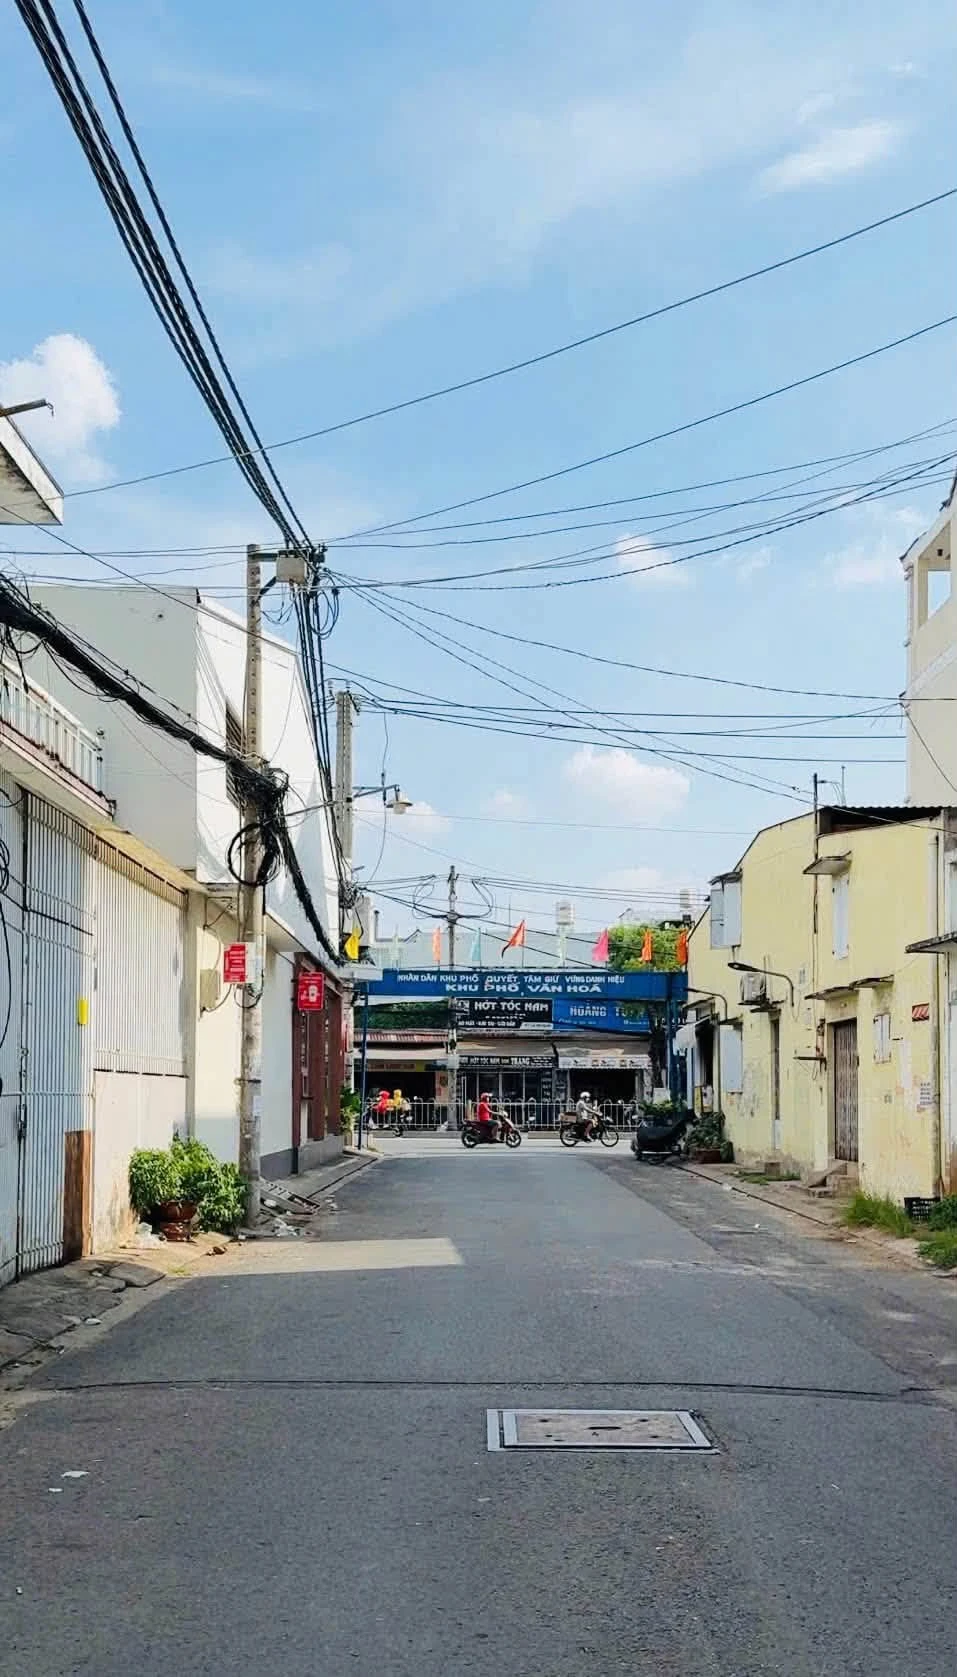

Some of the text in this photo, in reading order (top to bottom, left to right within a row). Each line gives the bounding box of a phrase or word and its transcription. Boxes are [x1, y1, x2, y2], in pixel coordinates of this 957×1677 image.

[440, 975, 457, 983] KHU
[460, 973, 479, 983] PHỐ
[523, 974, 542, 983] TÂM
[445, 984, 479, 992] KHU
[484, 981, 521, 992] PHỐ
[527, 983, 563, 993] VĂN
[500, 1000, 521, 1011] TÓC
[524, 1002, 549, 1012] NAM
